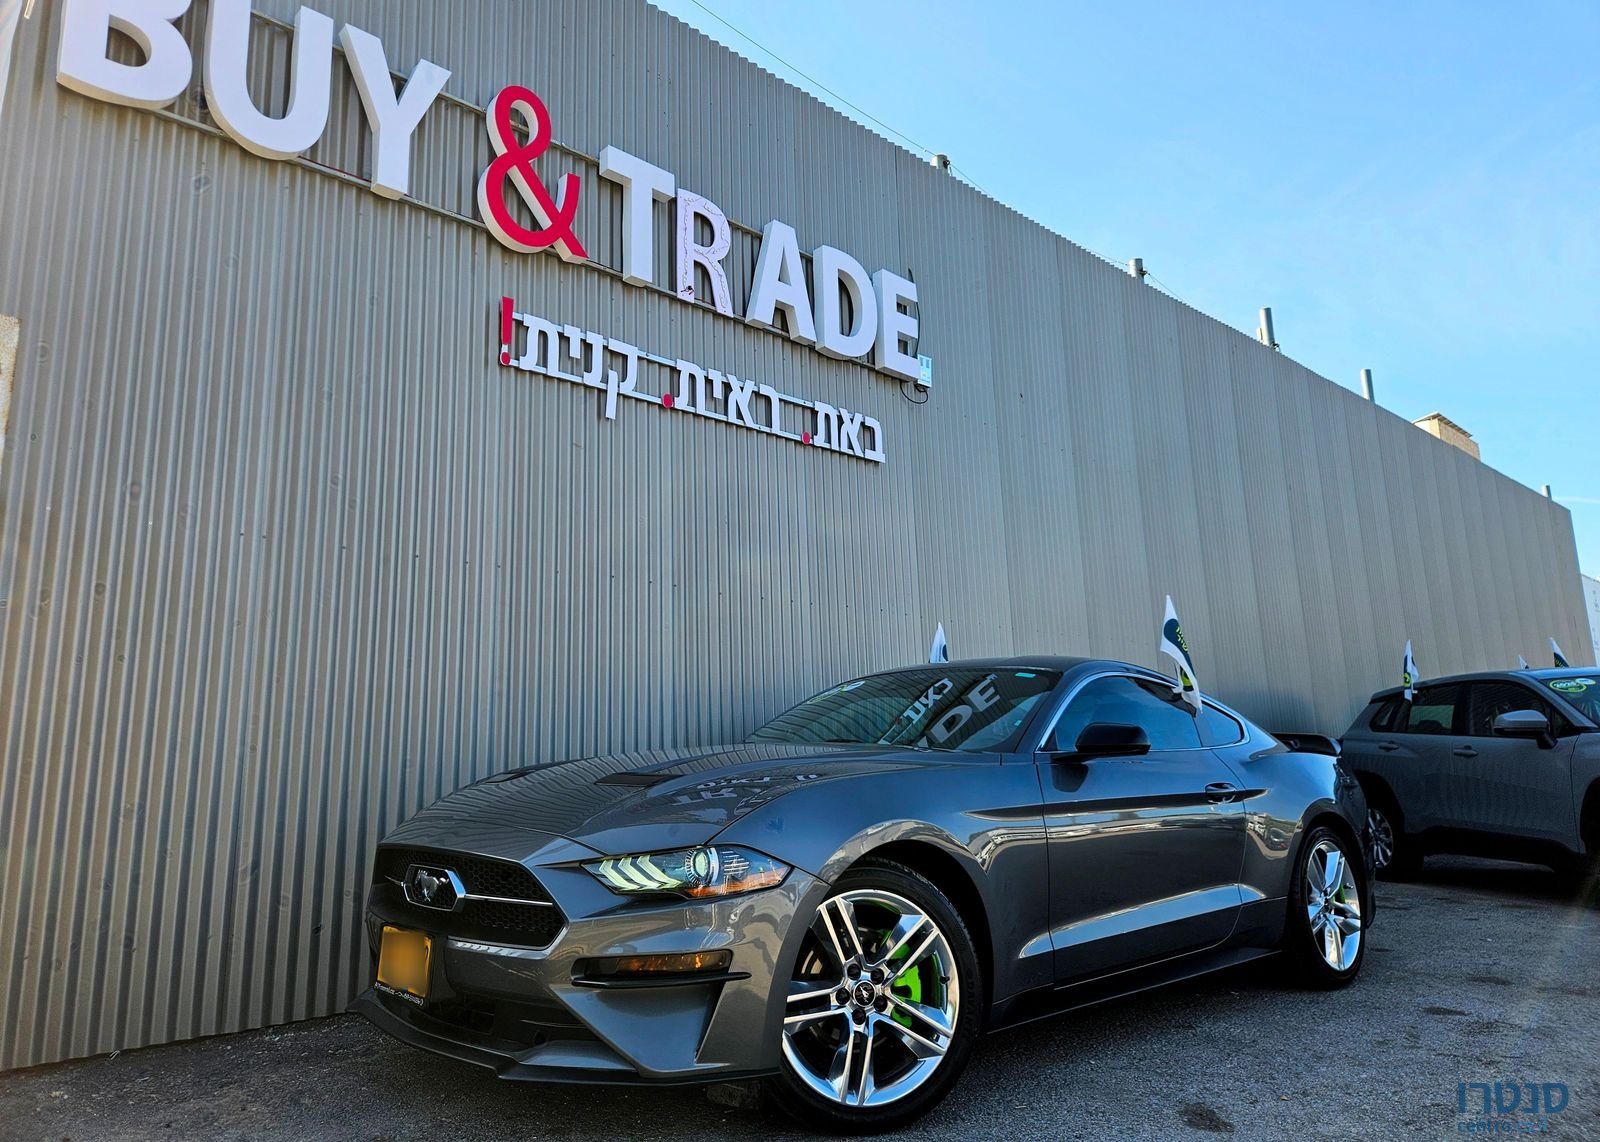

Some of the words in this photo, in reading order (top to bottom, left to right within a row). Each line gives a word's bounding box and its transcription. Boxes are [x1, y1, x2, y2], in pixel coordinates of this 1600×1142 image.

[57, 0, 451, 199] BUY
[477, 85, 588, 263] &
[599, 145, 921, 381] TRADE
[500, 295, 638, 420] קנית!
